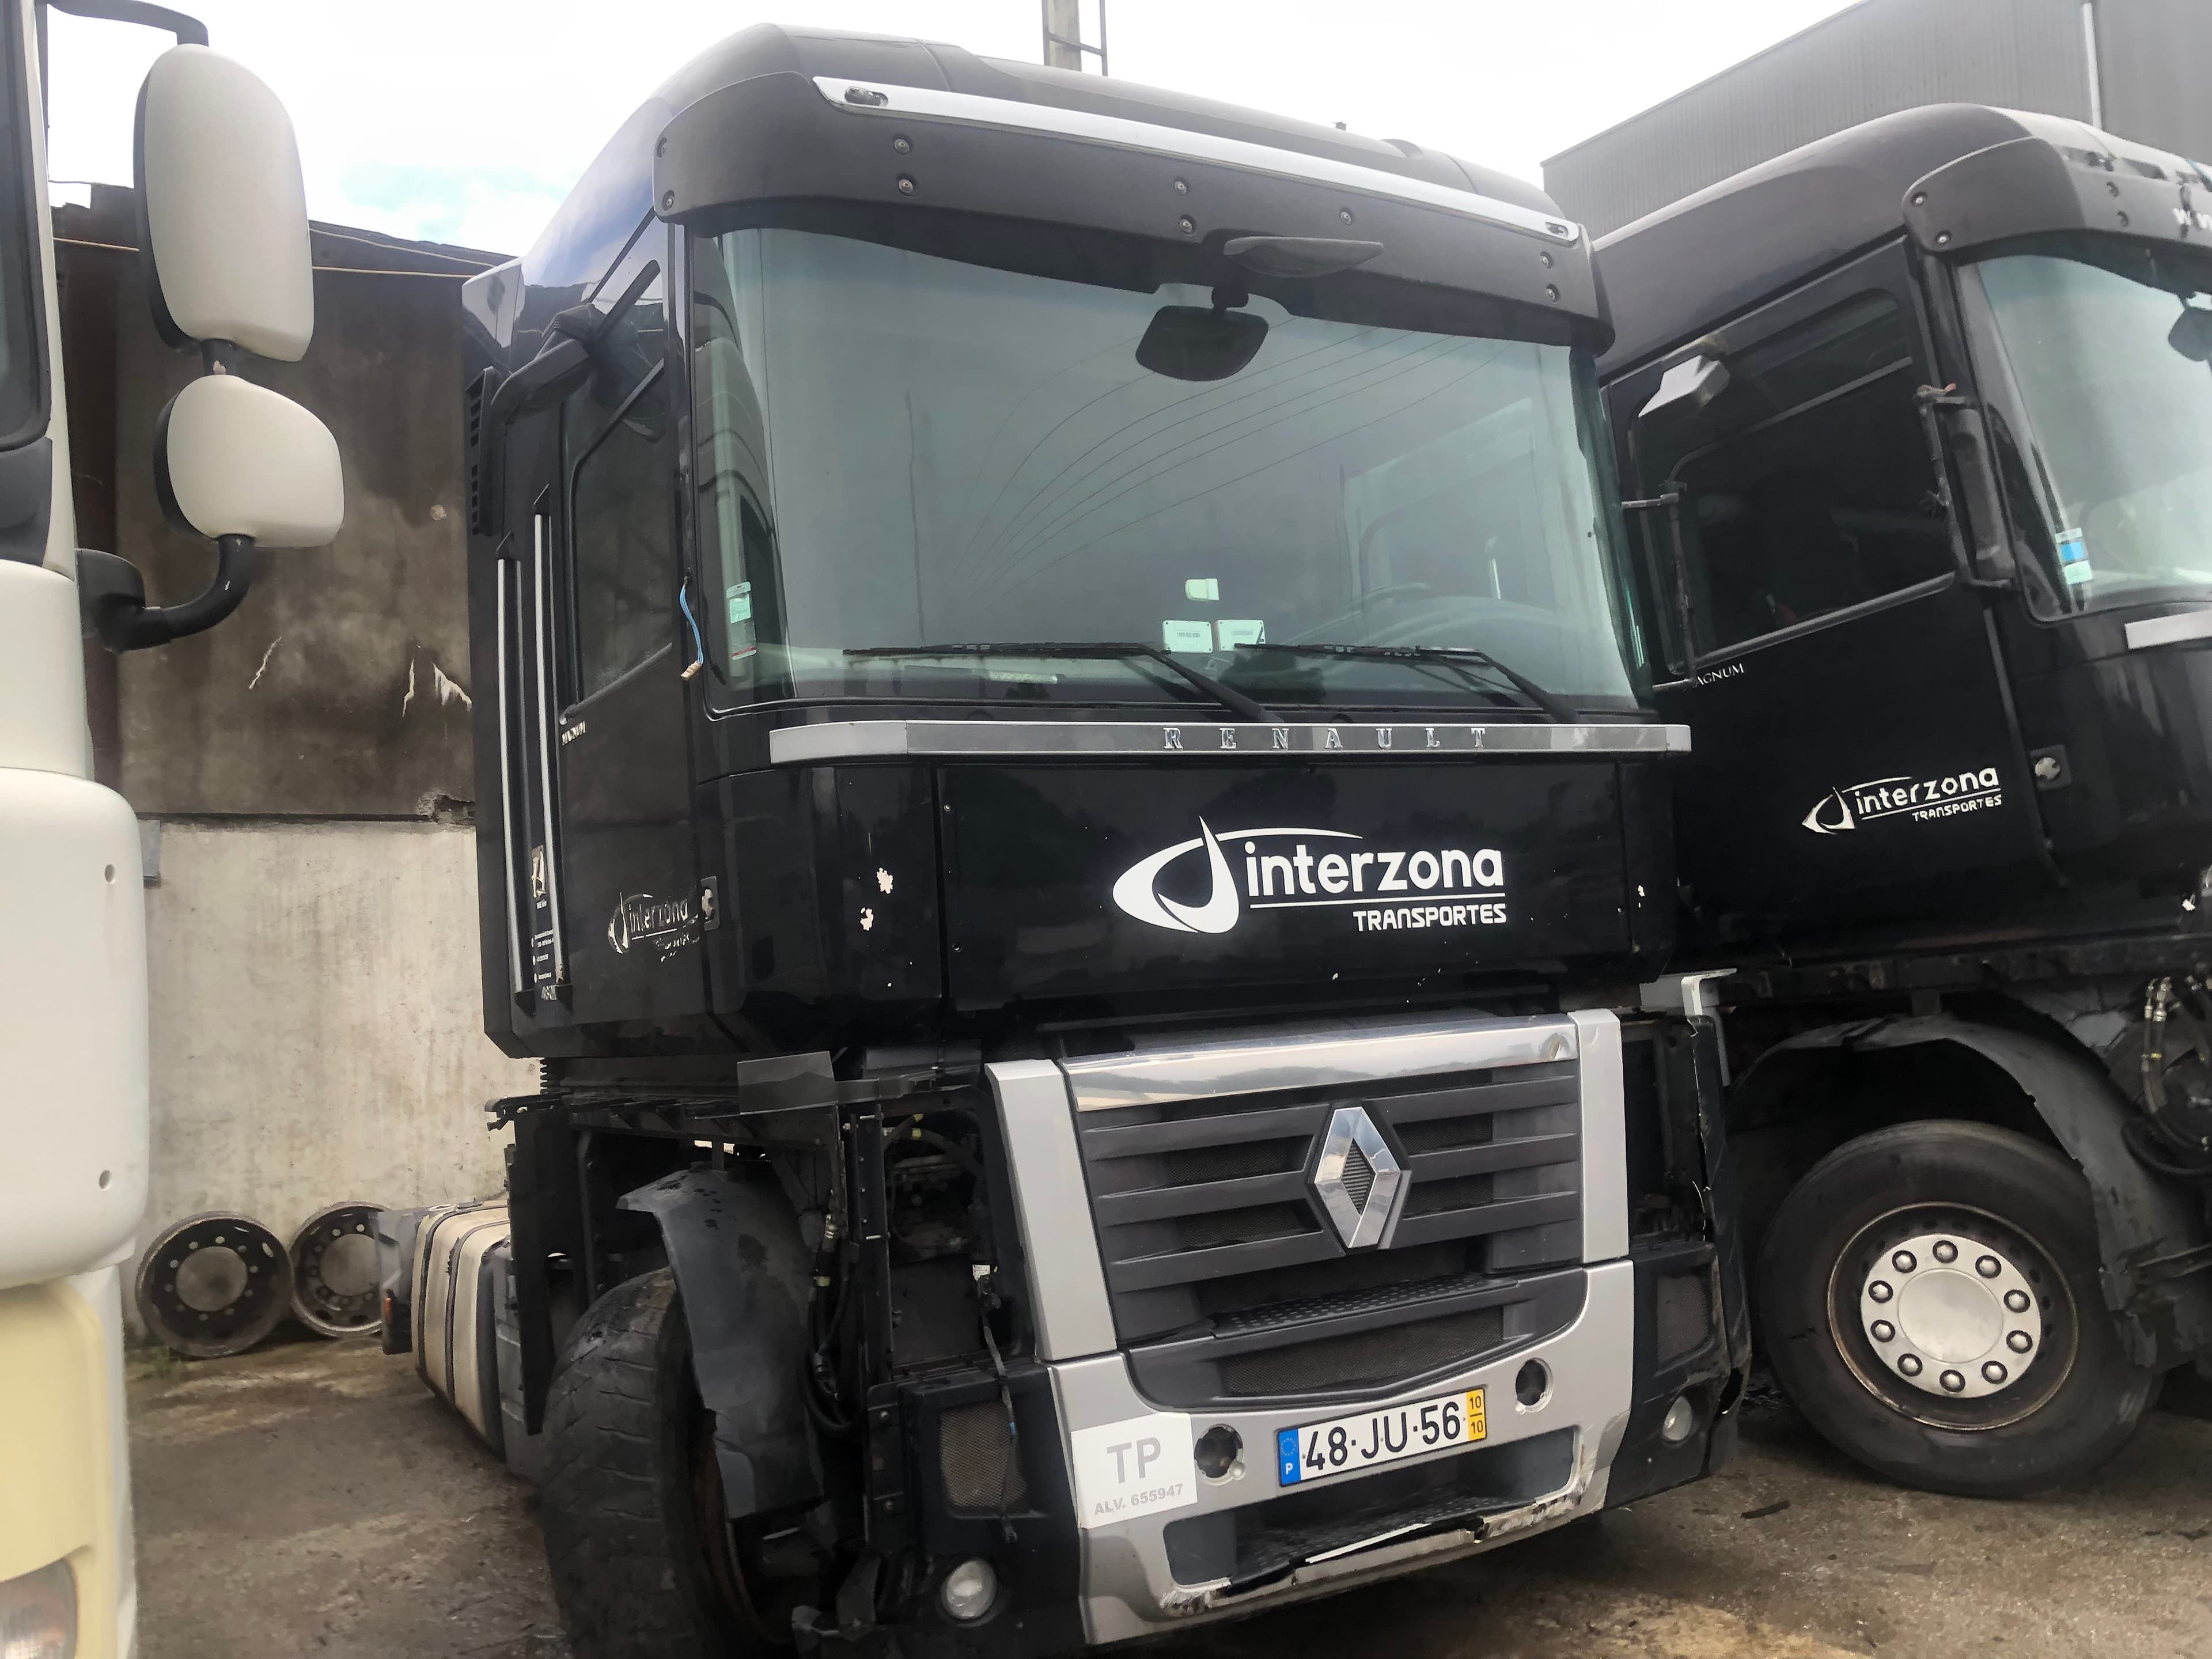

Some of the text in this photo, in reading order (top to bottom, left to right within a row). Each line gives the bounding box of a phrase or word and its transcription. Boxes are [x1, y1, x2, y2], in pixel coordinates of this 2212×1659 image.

[1692, 663, 1744, 688] AGNUM
[1163, 727, 1486, 749] RENAULT
[1854, 767, 1999, 815] interzona
[1911, 794, 2002, 822] TRANSPORTES
[1245, 841, 1505, 897] interzona
[1353, 903, 1508, 931] TRANSPORTES
[1469, 1396, 1482, 1410] 10
[1471, 1420, 1484, 1434] 10
[1106, 1437, 1161, 1484] TP
[1285, 1462, 1293, 1475] P
[1094, 1483, 1183, 1516] ALV. 655947
